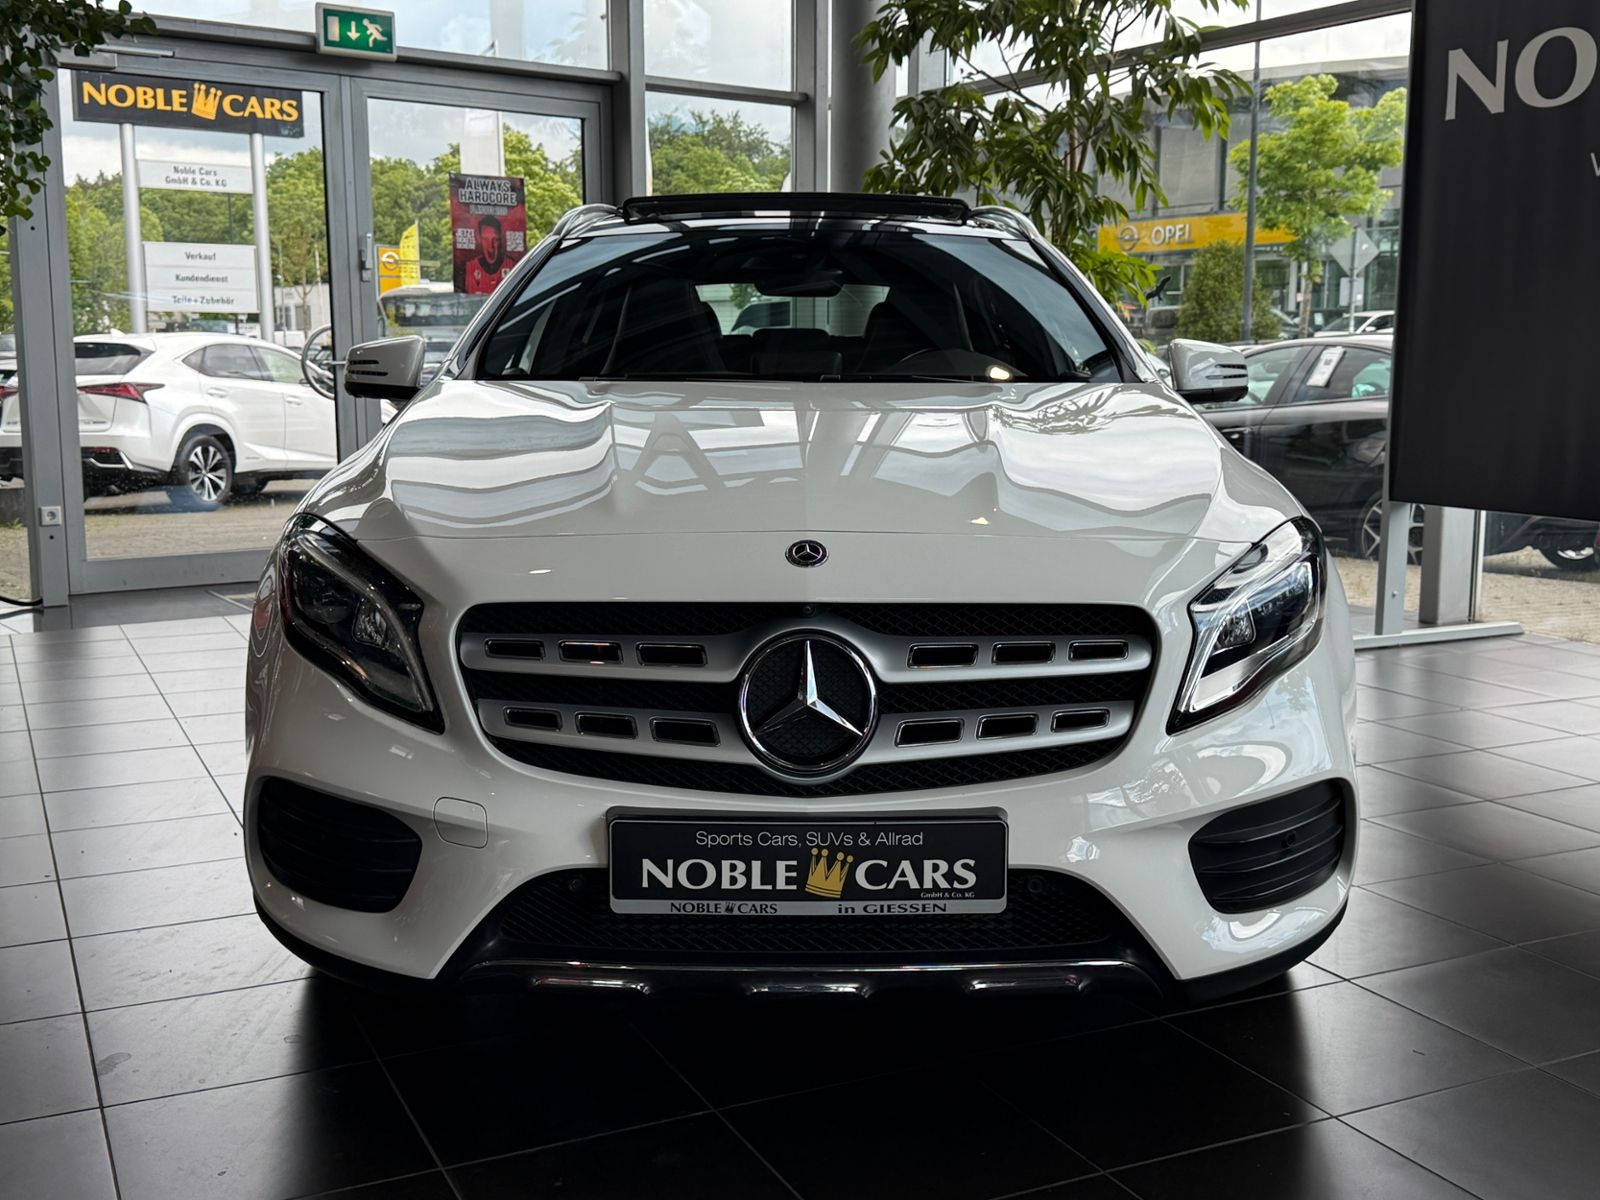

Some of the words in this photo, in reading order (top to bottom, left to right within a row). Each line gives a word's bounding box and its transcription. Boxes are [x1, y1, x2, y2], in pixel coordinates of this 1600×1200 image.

[1445, 26, 1598, 121] NO
[82, 81, 188, 112] NOBLE
[222, 94, 299, 122] CARS
[173, 166, 196, 175] Noble
[198, 167, 217, 177] Cars
[165, 176, 189, 185] GmbH
[190, 178, 198, 186] &
[200, 178, 213, 187] Co.
[215, 180, 228, 188] KG
[465, 177, 511, 193] ALWAYS
[458, 188, 517, 206] HARDCORE
[1151, 224, 1192, 246] OPEL
[185, 251, 217, 261] Verkauf
[175, 273, 229, 283] Kundendienst
[696, 830, 753, 848] Sports
[757, 832, 802, 848] Cars,
[806, 832, 853, 847] SUVs
[858, 832, 871, 846] &
[875, 832, 924, 846] Allrad
[642, 858, 798, 890] NOBLE
[855, 858, 977, 890] CARS
[921, 891, 943, 899] GmbH
[670, 902, 722, 914] NOBLE
[737, 903, 778, 914] CARS
[837, 903, 856, 914] in
[863, 903, 947, 914] GIESSEN
